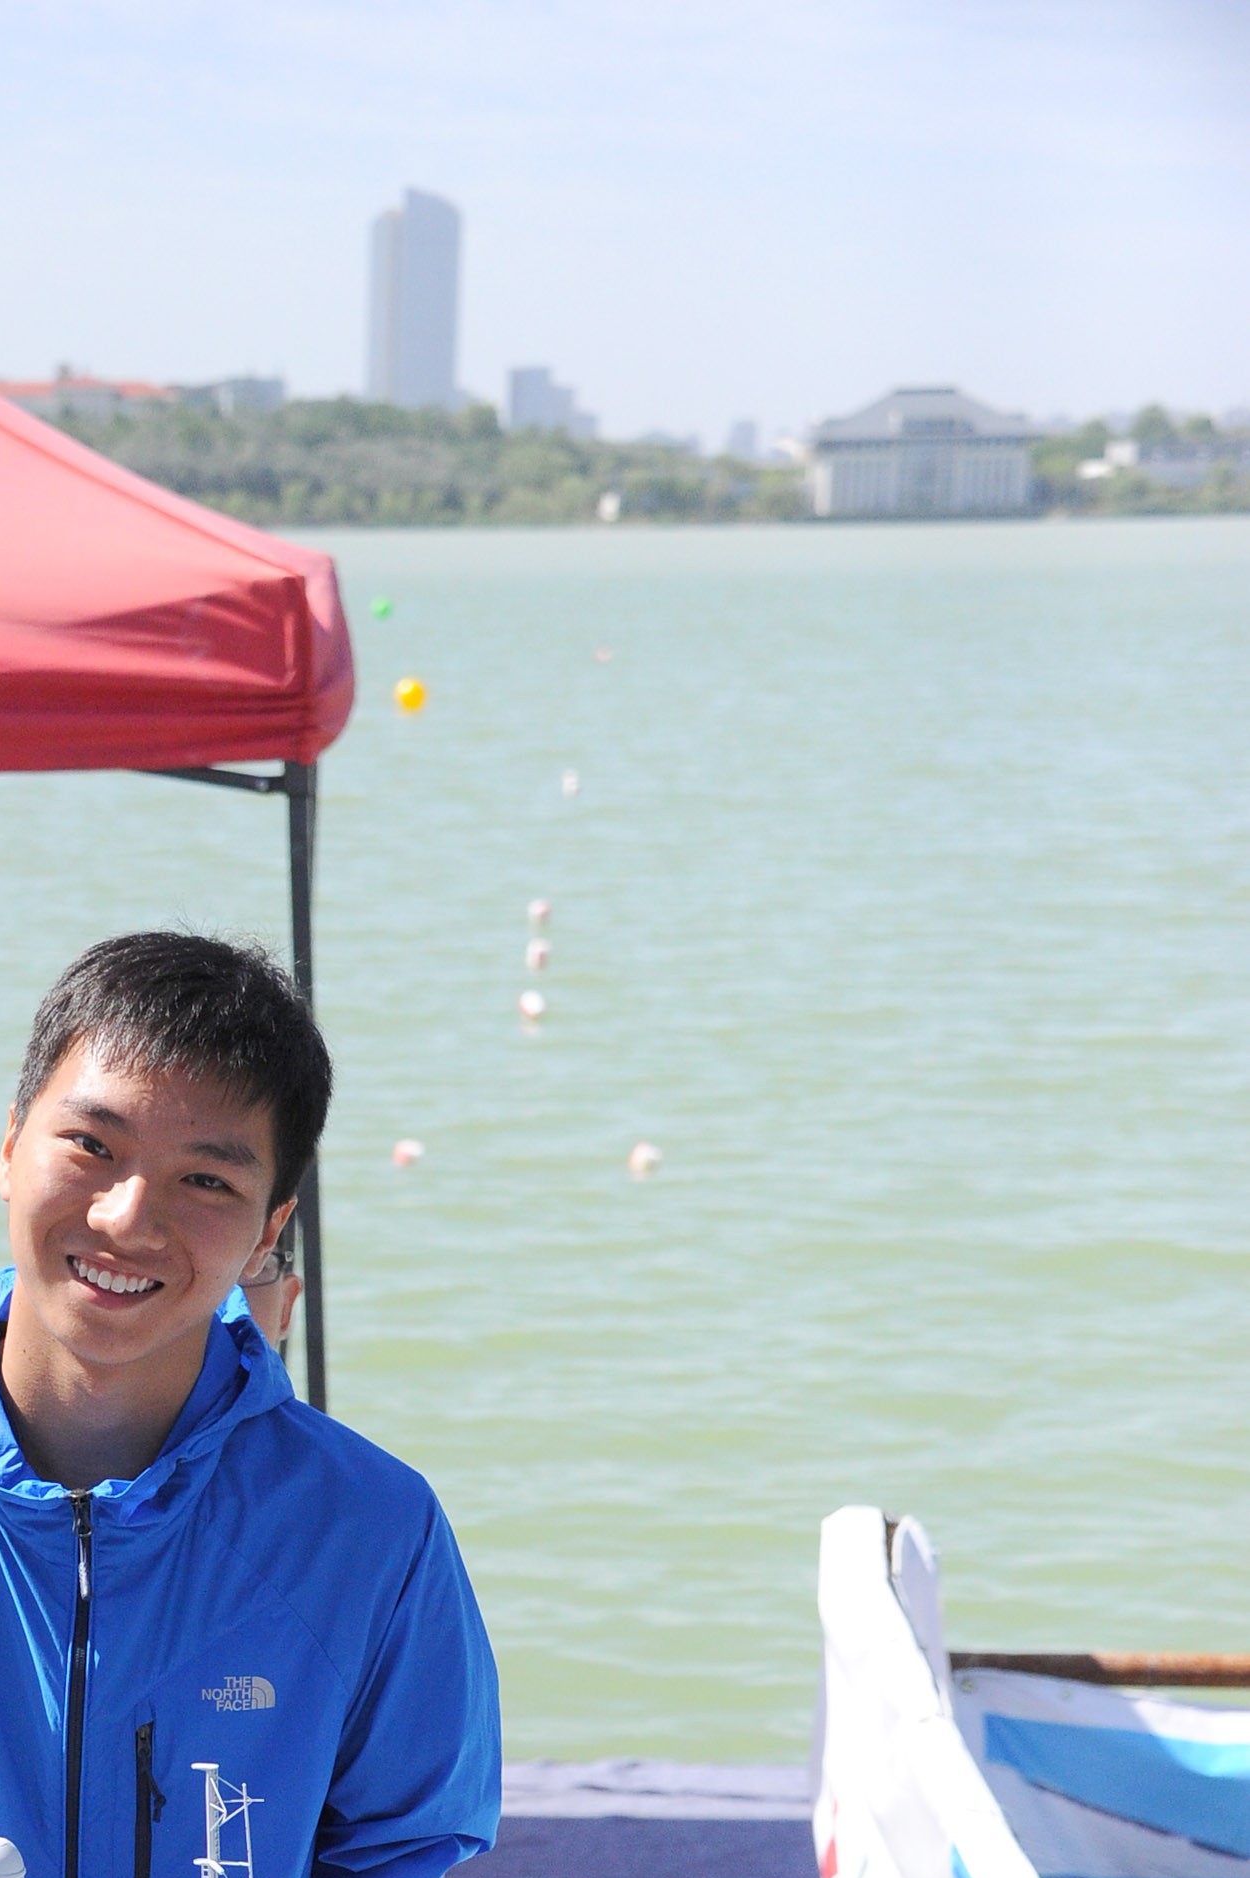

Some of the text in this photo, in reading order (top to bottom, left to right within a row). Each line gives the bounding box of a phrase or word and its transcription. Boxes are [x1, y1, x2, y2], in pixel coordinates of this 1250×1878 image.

[223, 1676, 251, 1689] THE
[201, 1688, 251, 1701] NORTH
[216, 1699, 251, 1712] FACE
